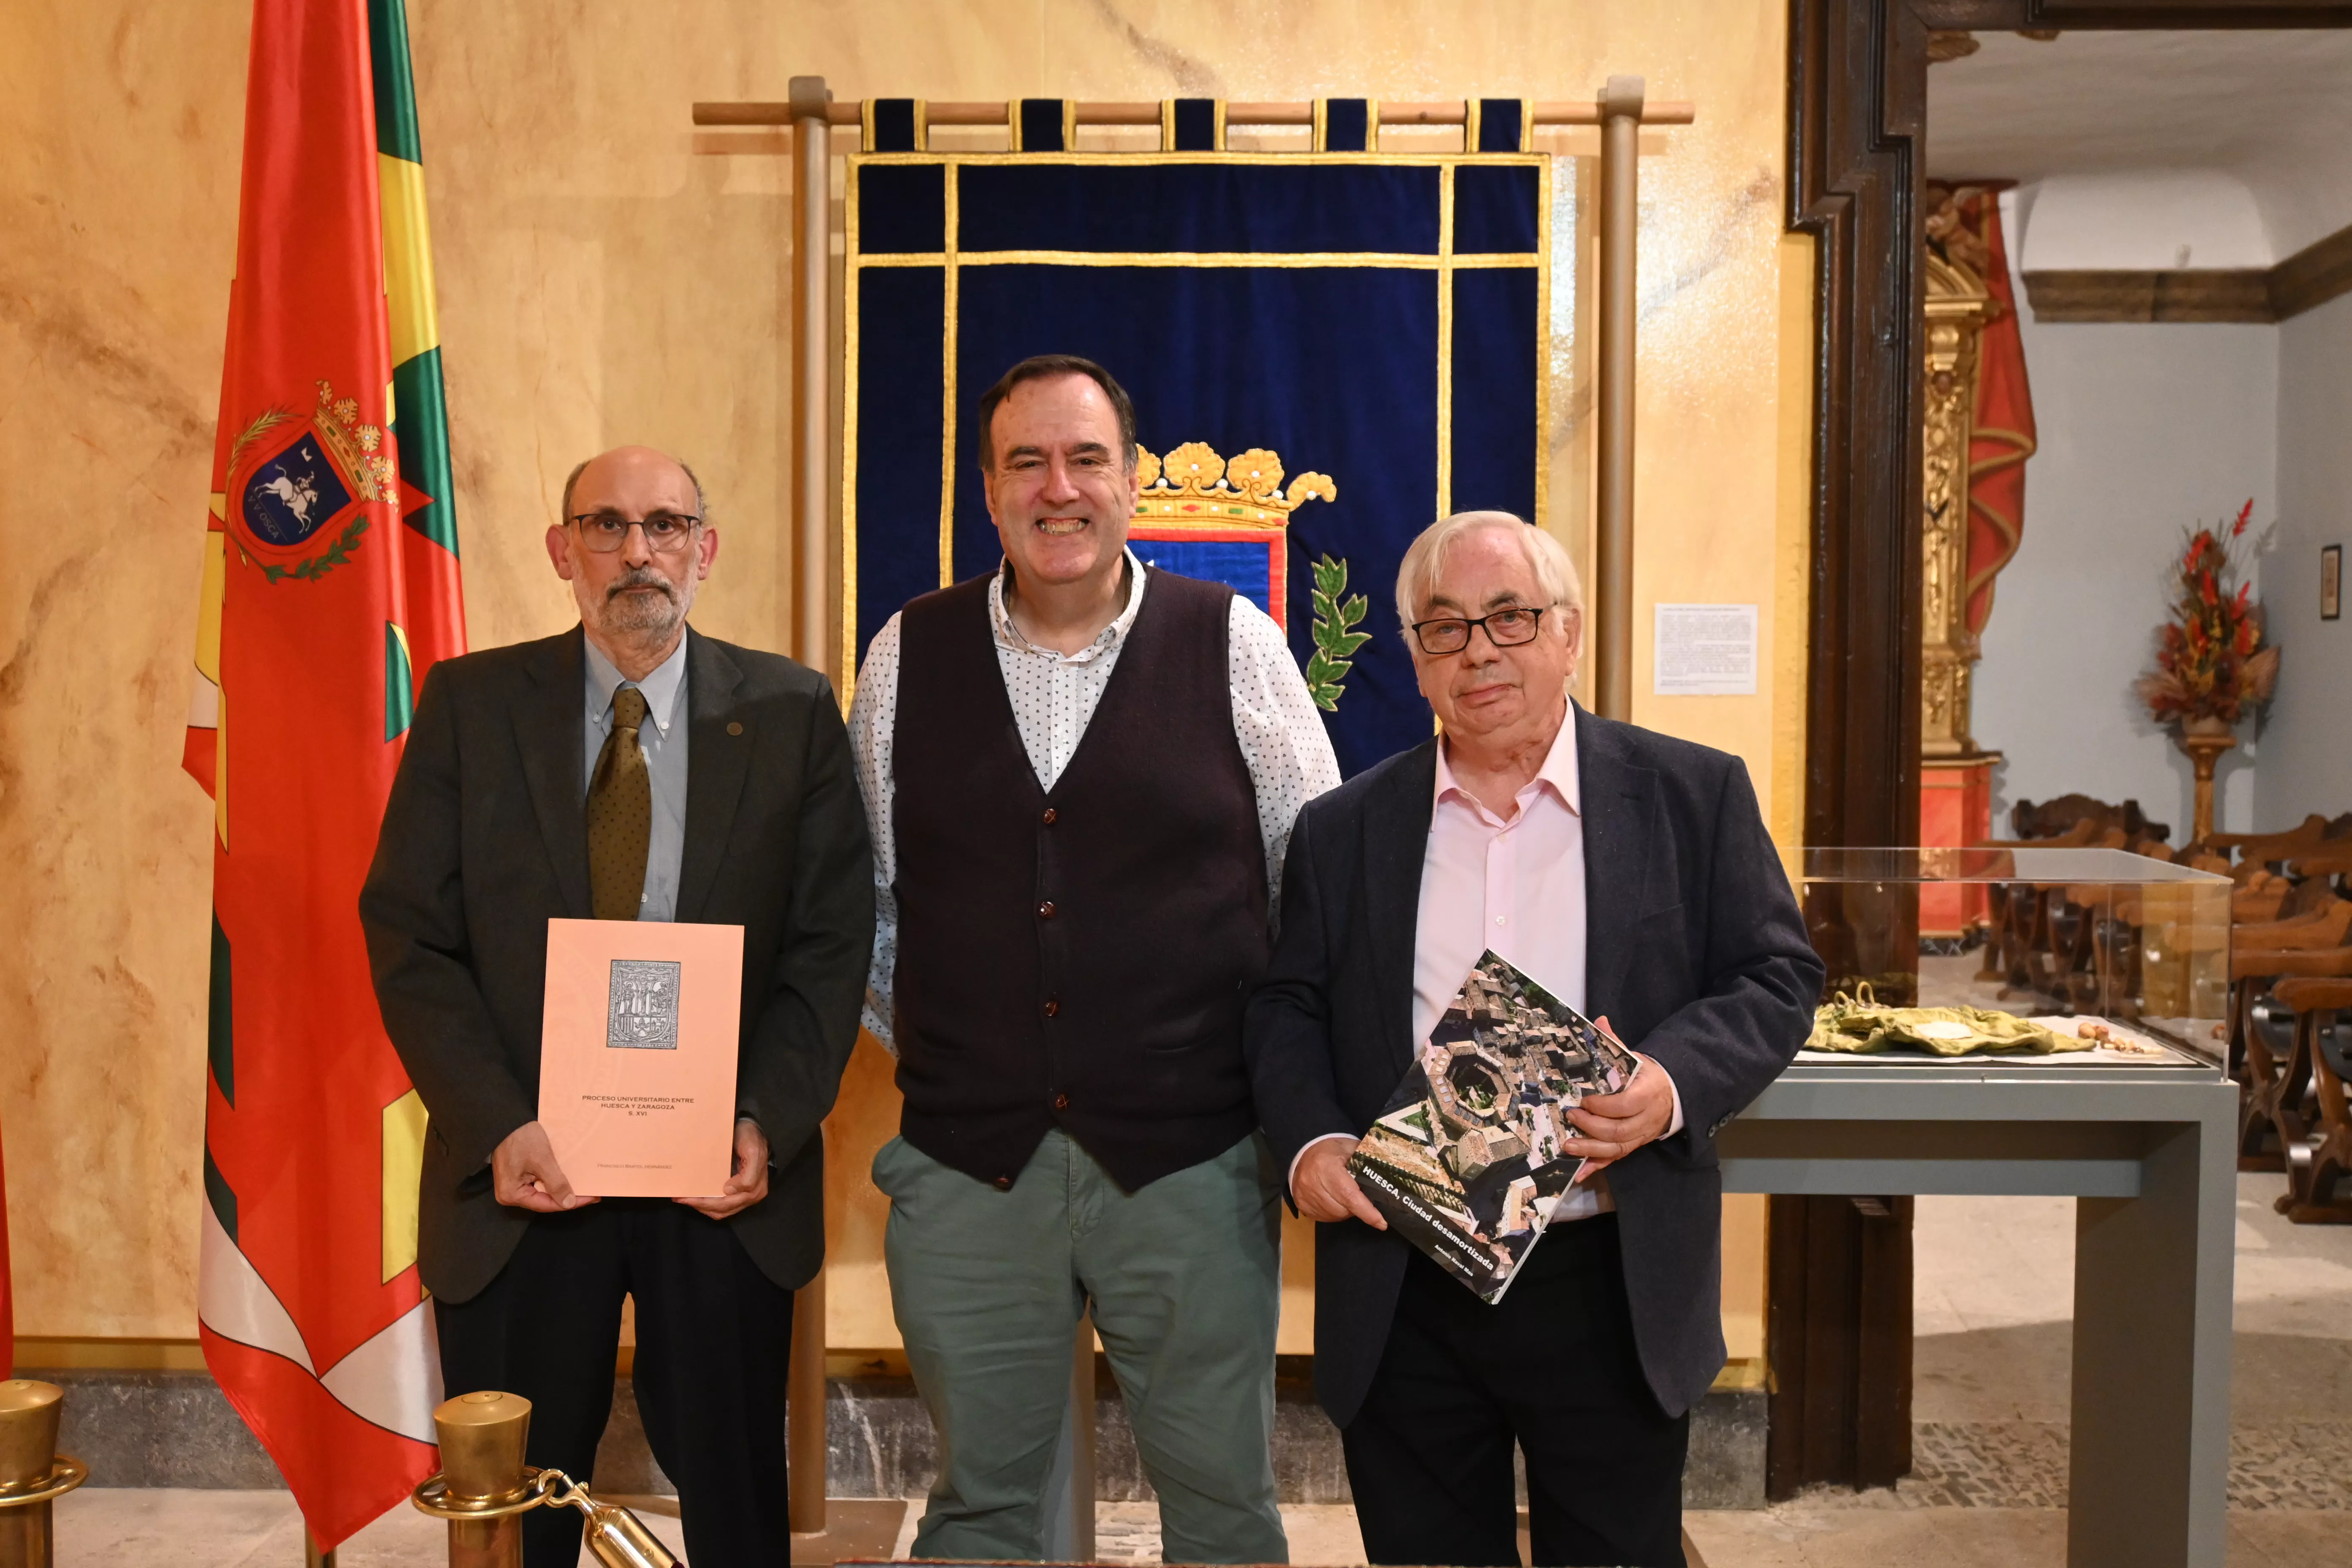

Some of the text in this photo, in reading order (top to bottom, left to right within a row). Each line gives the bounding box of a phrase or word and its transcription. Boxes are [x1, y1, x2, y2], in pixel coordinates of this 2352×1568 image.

[259, 512, 279, 539] OSCA
[1363, 1166, 1493, 1271] HUESCA, Ciudad desamortizada
[1435, 1244, 1473, 1277] Antonio Naval Mas
